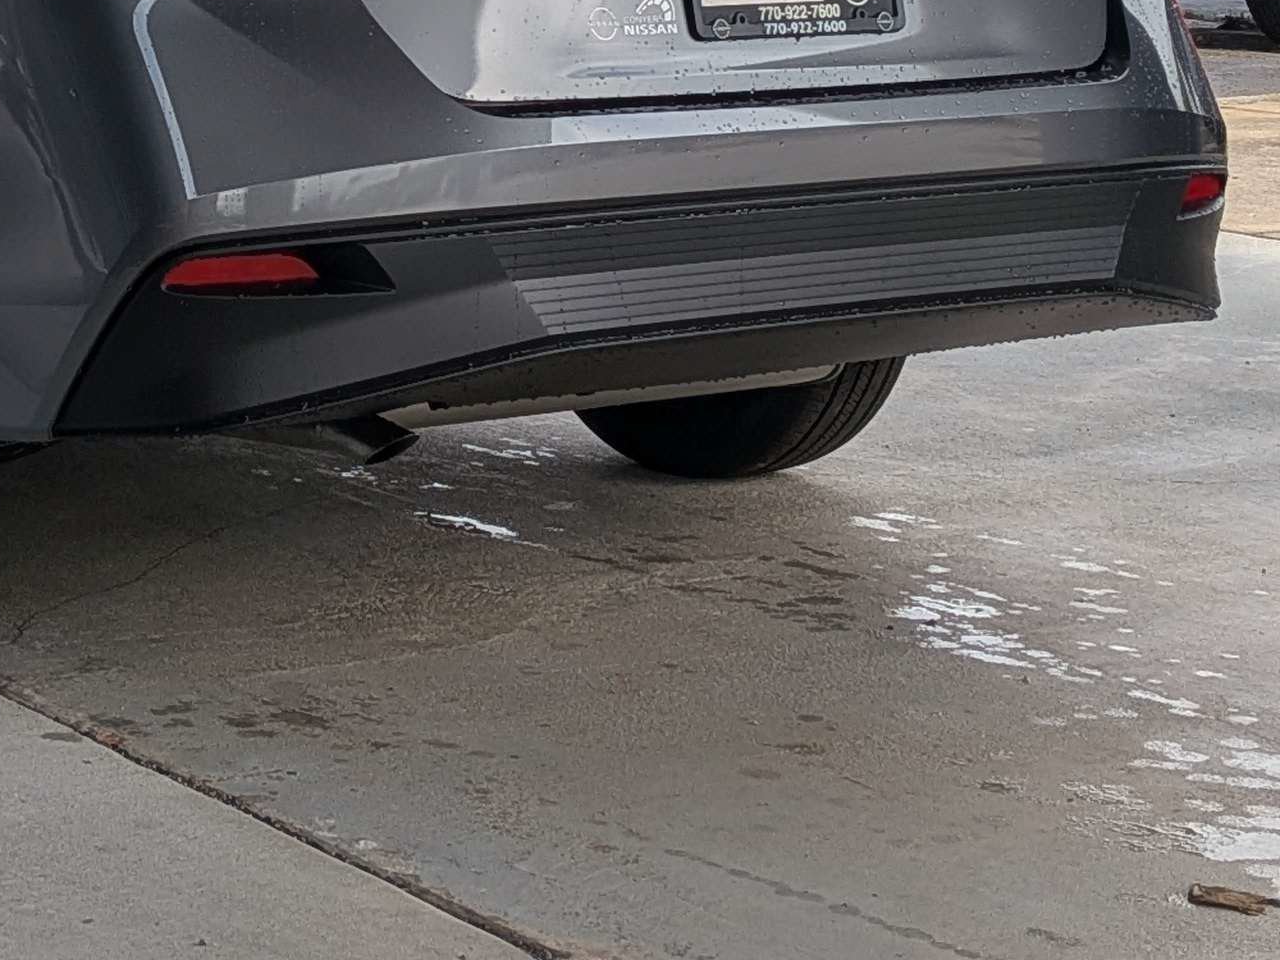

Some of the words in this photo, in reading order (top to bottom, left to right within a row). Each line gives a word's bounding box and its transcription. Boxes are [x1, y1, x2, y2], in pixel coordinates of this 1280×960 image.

[758, 3, 841, 21] 770-922-7600
[623, 23, 679, 36] NISSAN
[763, 20, 847, 36] 770-922-7600
